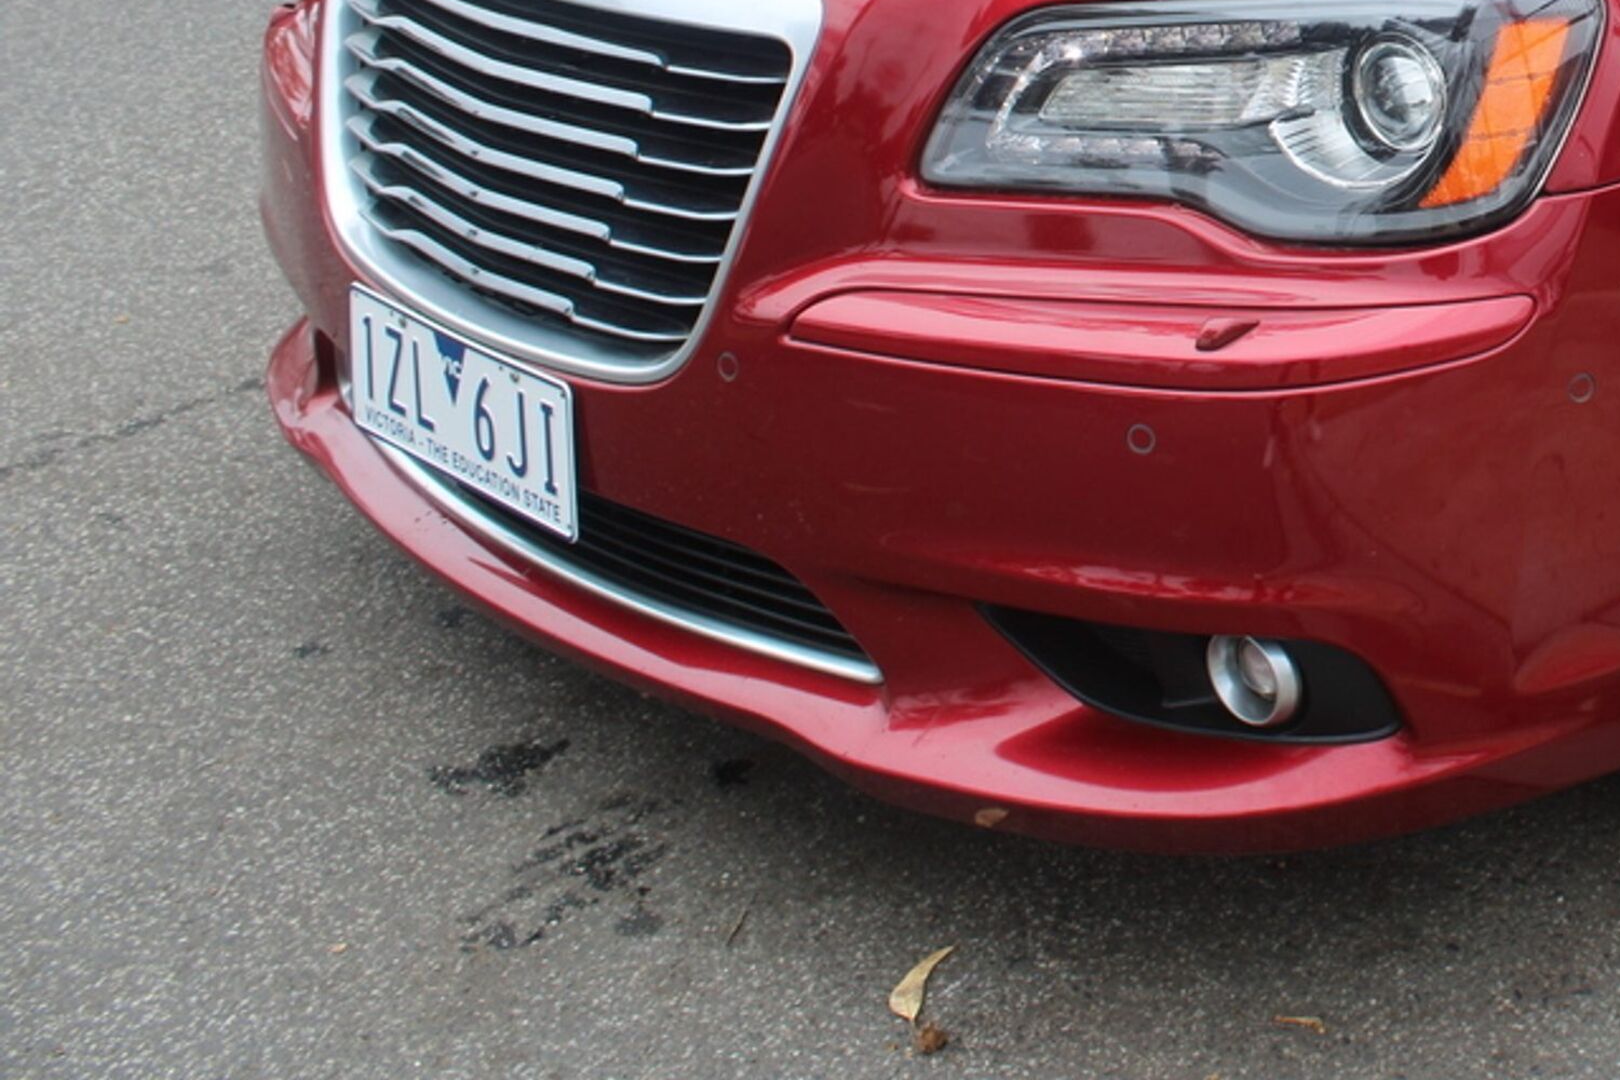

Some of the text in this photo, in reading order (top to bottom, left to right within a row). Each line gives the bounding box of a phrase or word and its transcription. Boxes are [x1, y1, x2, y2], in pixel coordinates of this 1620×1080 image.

[366, 409, 416, 443] VICTORIA
[428, 439, 449, 464] THE
[453, 452, 520, 499] EDUCATION
[523, 490, 562, 523] STATE
